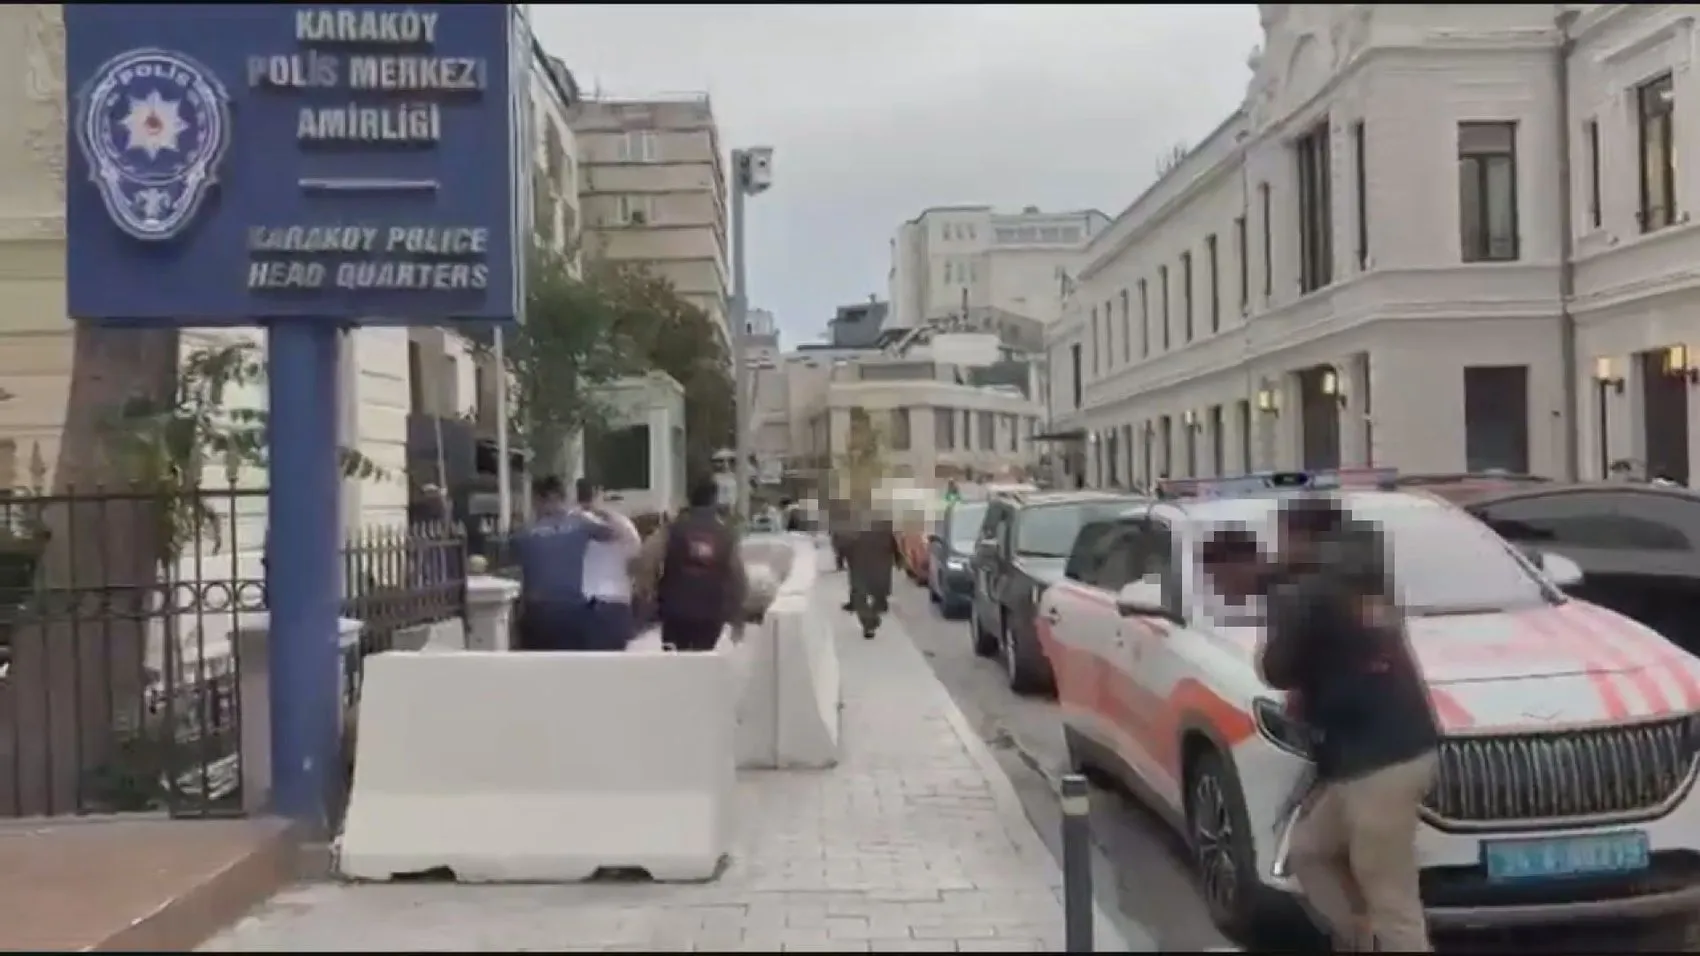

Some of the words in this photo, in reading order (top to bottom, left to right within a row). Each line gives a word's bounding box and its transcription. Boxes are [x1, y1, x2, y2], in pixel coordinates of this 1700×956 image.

[247, 50, 340, 87] POLİS
[386, 226, 489, 253] POLICE
[247, 260, 326, 288] HEAD
[336, 260, 489, 289] QUARTERS
